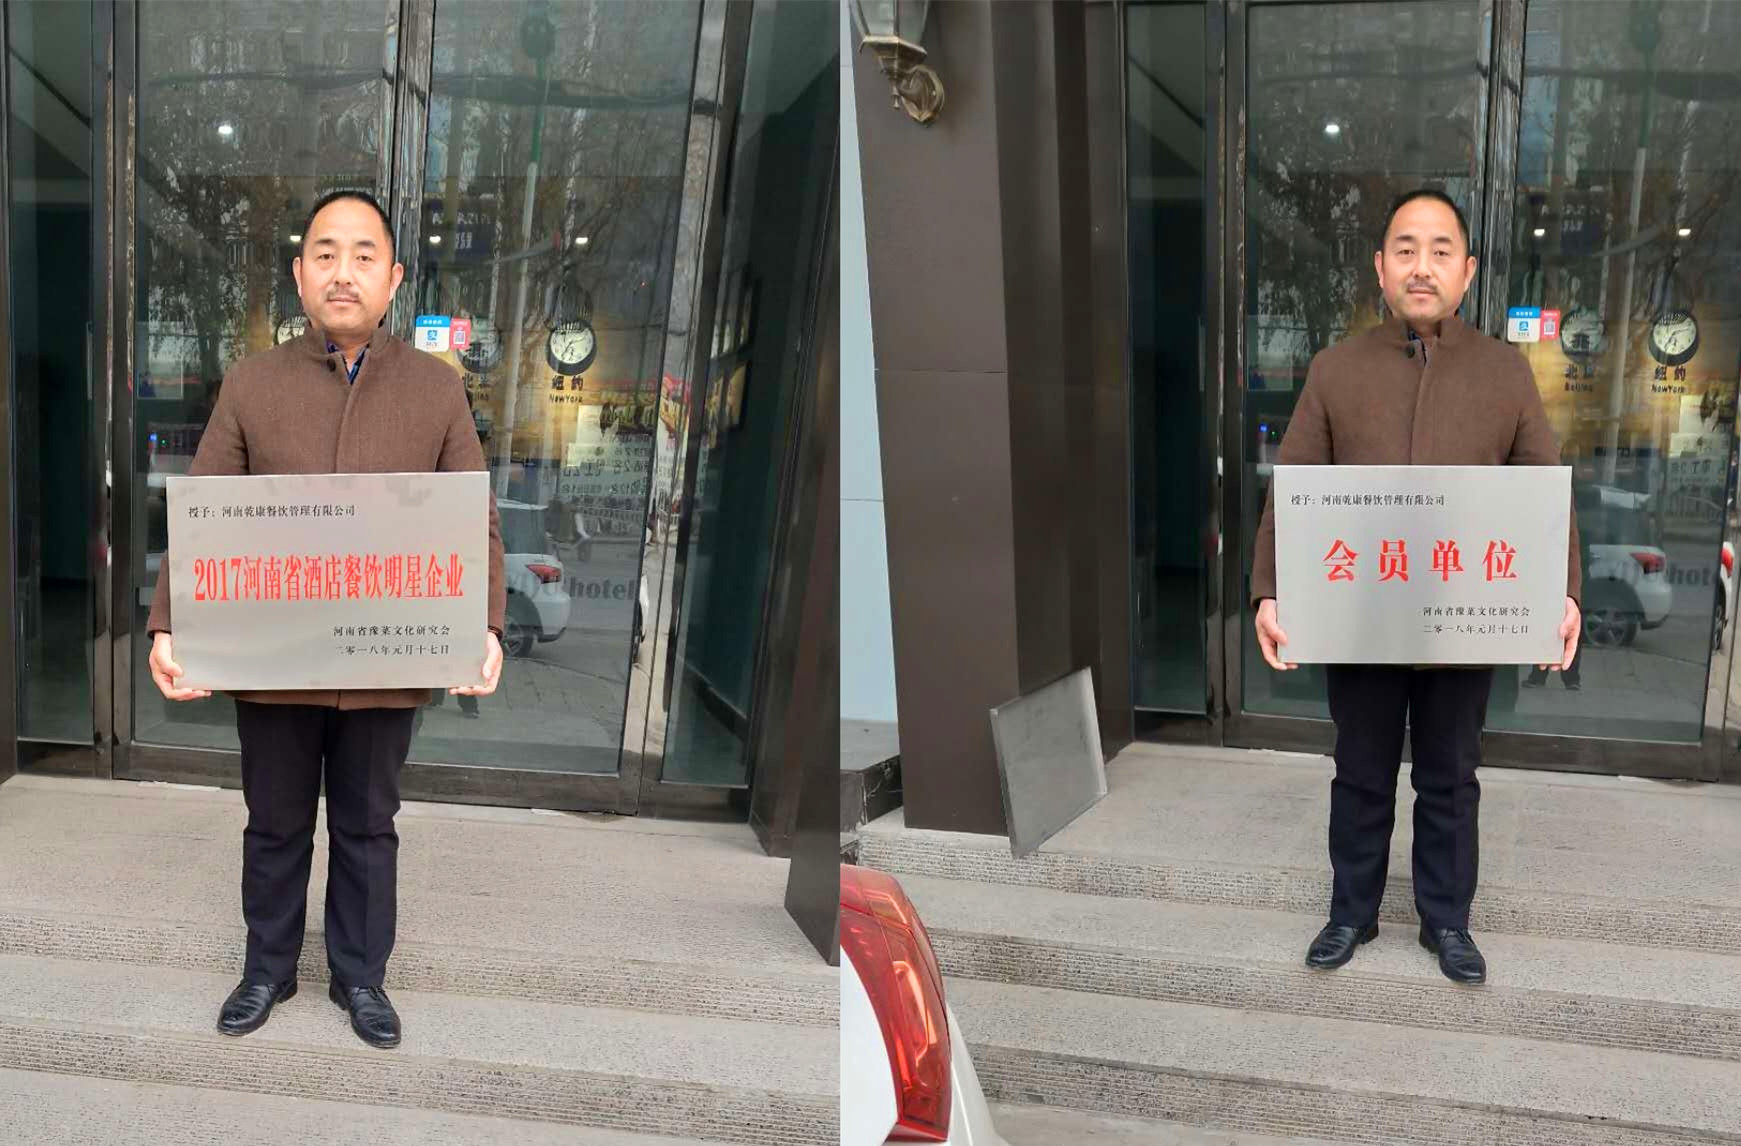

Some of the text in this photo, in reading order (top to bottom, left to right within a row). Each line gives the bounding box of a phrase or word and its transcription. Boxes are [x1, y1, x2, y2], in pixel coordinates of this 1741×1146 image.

[1323, 539, 1517, 582] 会员单位
[193, 552, 464, 602] 2017河南省酒店餐饮明星企业
[1422, 606, 1530, 617] 河南省豫菜文化研究会
[333, 625, 450, 637] 河南省豫菜文化研究会
[1422, 623, 1528, 634] 二零一八年元月十七日
